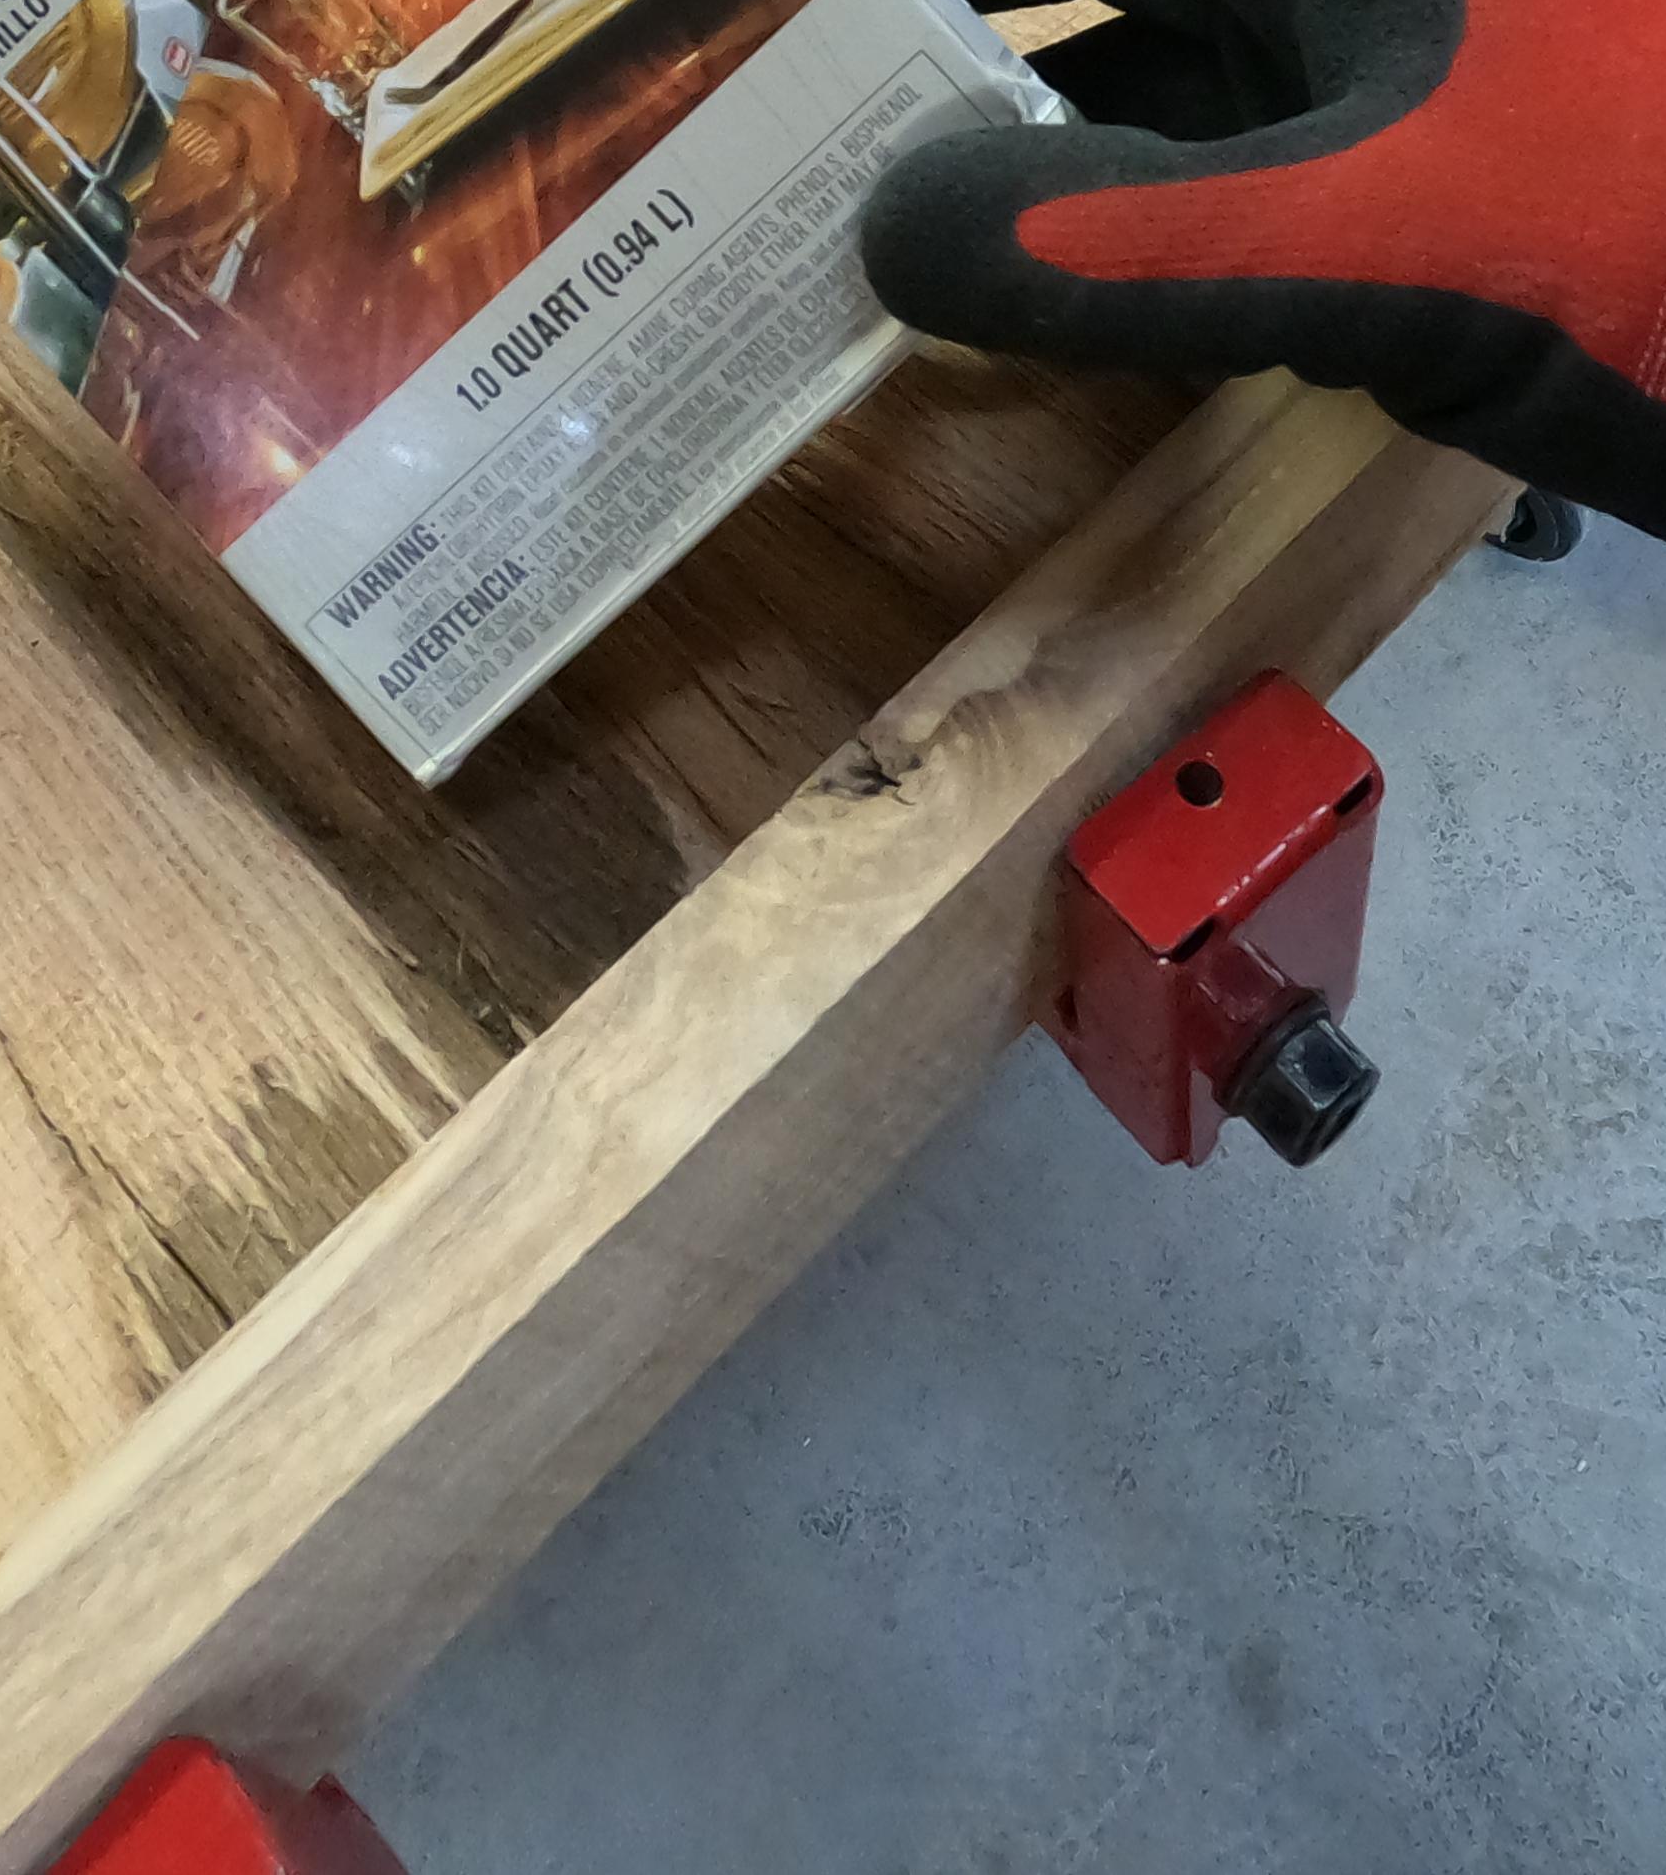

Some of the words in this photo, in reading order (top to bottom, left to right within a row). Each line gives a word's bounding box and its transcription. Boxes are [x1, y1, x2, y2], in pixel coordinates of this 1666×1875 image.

[456, 365, 502, 412] 1.0
[490, 277, 589, 377] QUART
[581, 218, 659, 297] (0.94
[646, 188, 694, 232] L)
[323, 513, 449, 635] WARNING:
[373, 549, 537, 703] ADVERTENCIA:
